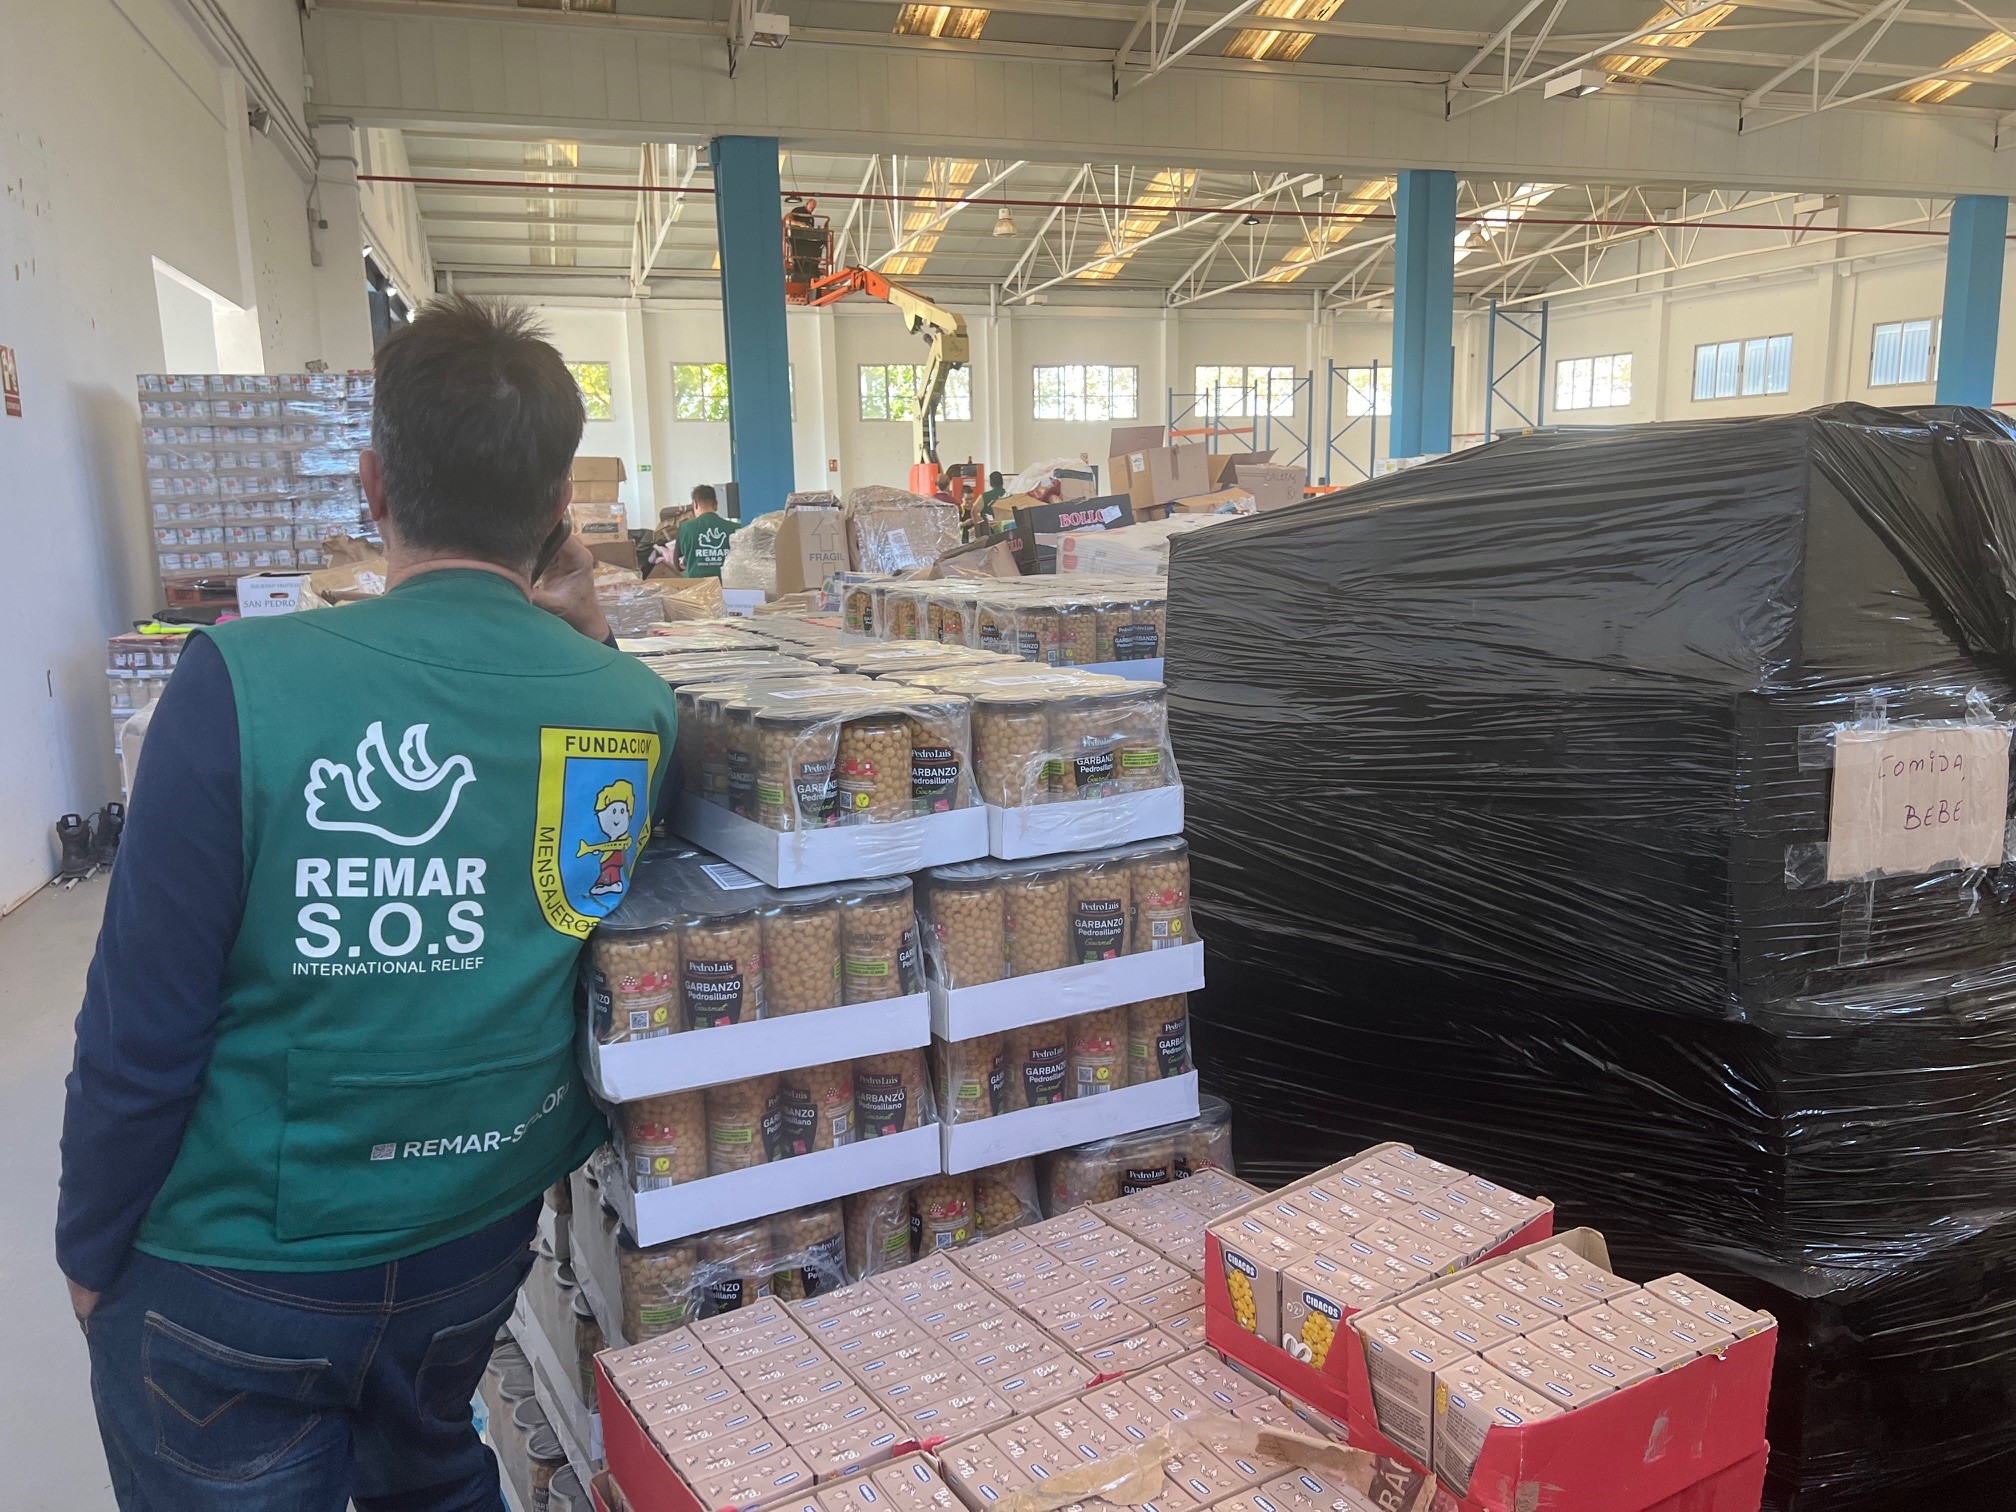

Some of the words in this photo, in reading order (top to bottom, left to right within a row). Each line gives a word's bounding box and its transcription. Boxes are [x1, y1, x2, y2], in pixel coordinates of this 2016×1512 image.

[809, 553, 845, 562] FRAGIL
[243, 600, 261, 608] SAN
[265, 600, 296, 608] PEDRO
[565, 735, 651, 754] FUNDACION
[913, 777, 955, 785] edrosillano
[1903, 800, 1963, 830] BEBE
[295, 857, 487, 898] REMAR
[295, 900, 485, 958] S.O.S
[1075, 918, 1124, 929] GARBANZO
[1078, 928, 1122, 936] Pedrosillano
[292, 960, 427, 976] INTERNATIONAL
[431, 957, 485, 972] RELIEF
[685, 980, 741, 993] GARBANZO
[688, 990, 738, 1001] Pedrosillano
[1227, 1253, 1256, 1277] CIDACOS
[711, 1283, 740, 1292] ANZO
[1305, 1294, 1339, 1318] CIDACOS
